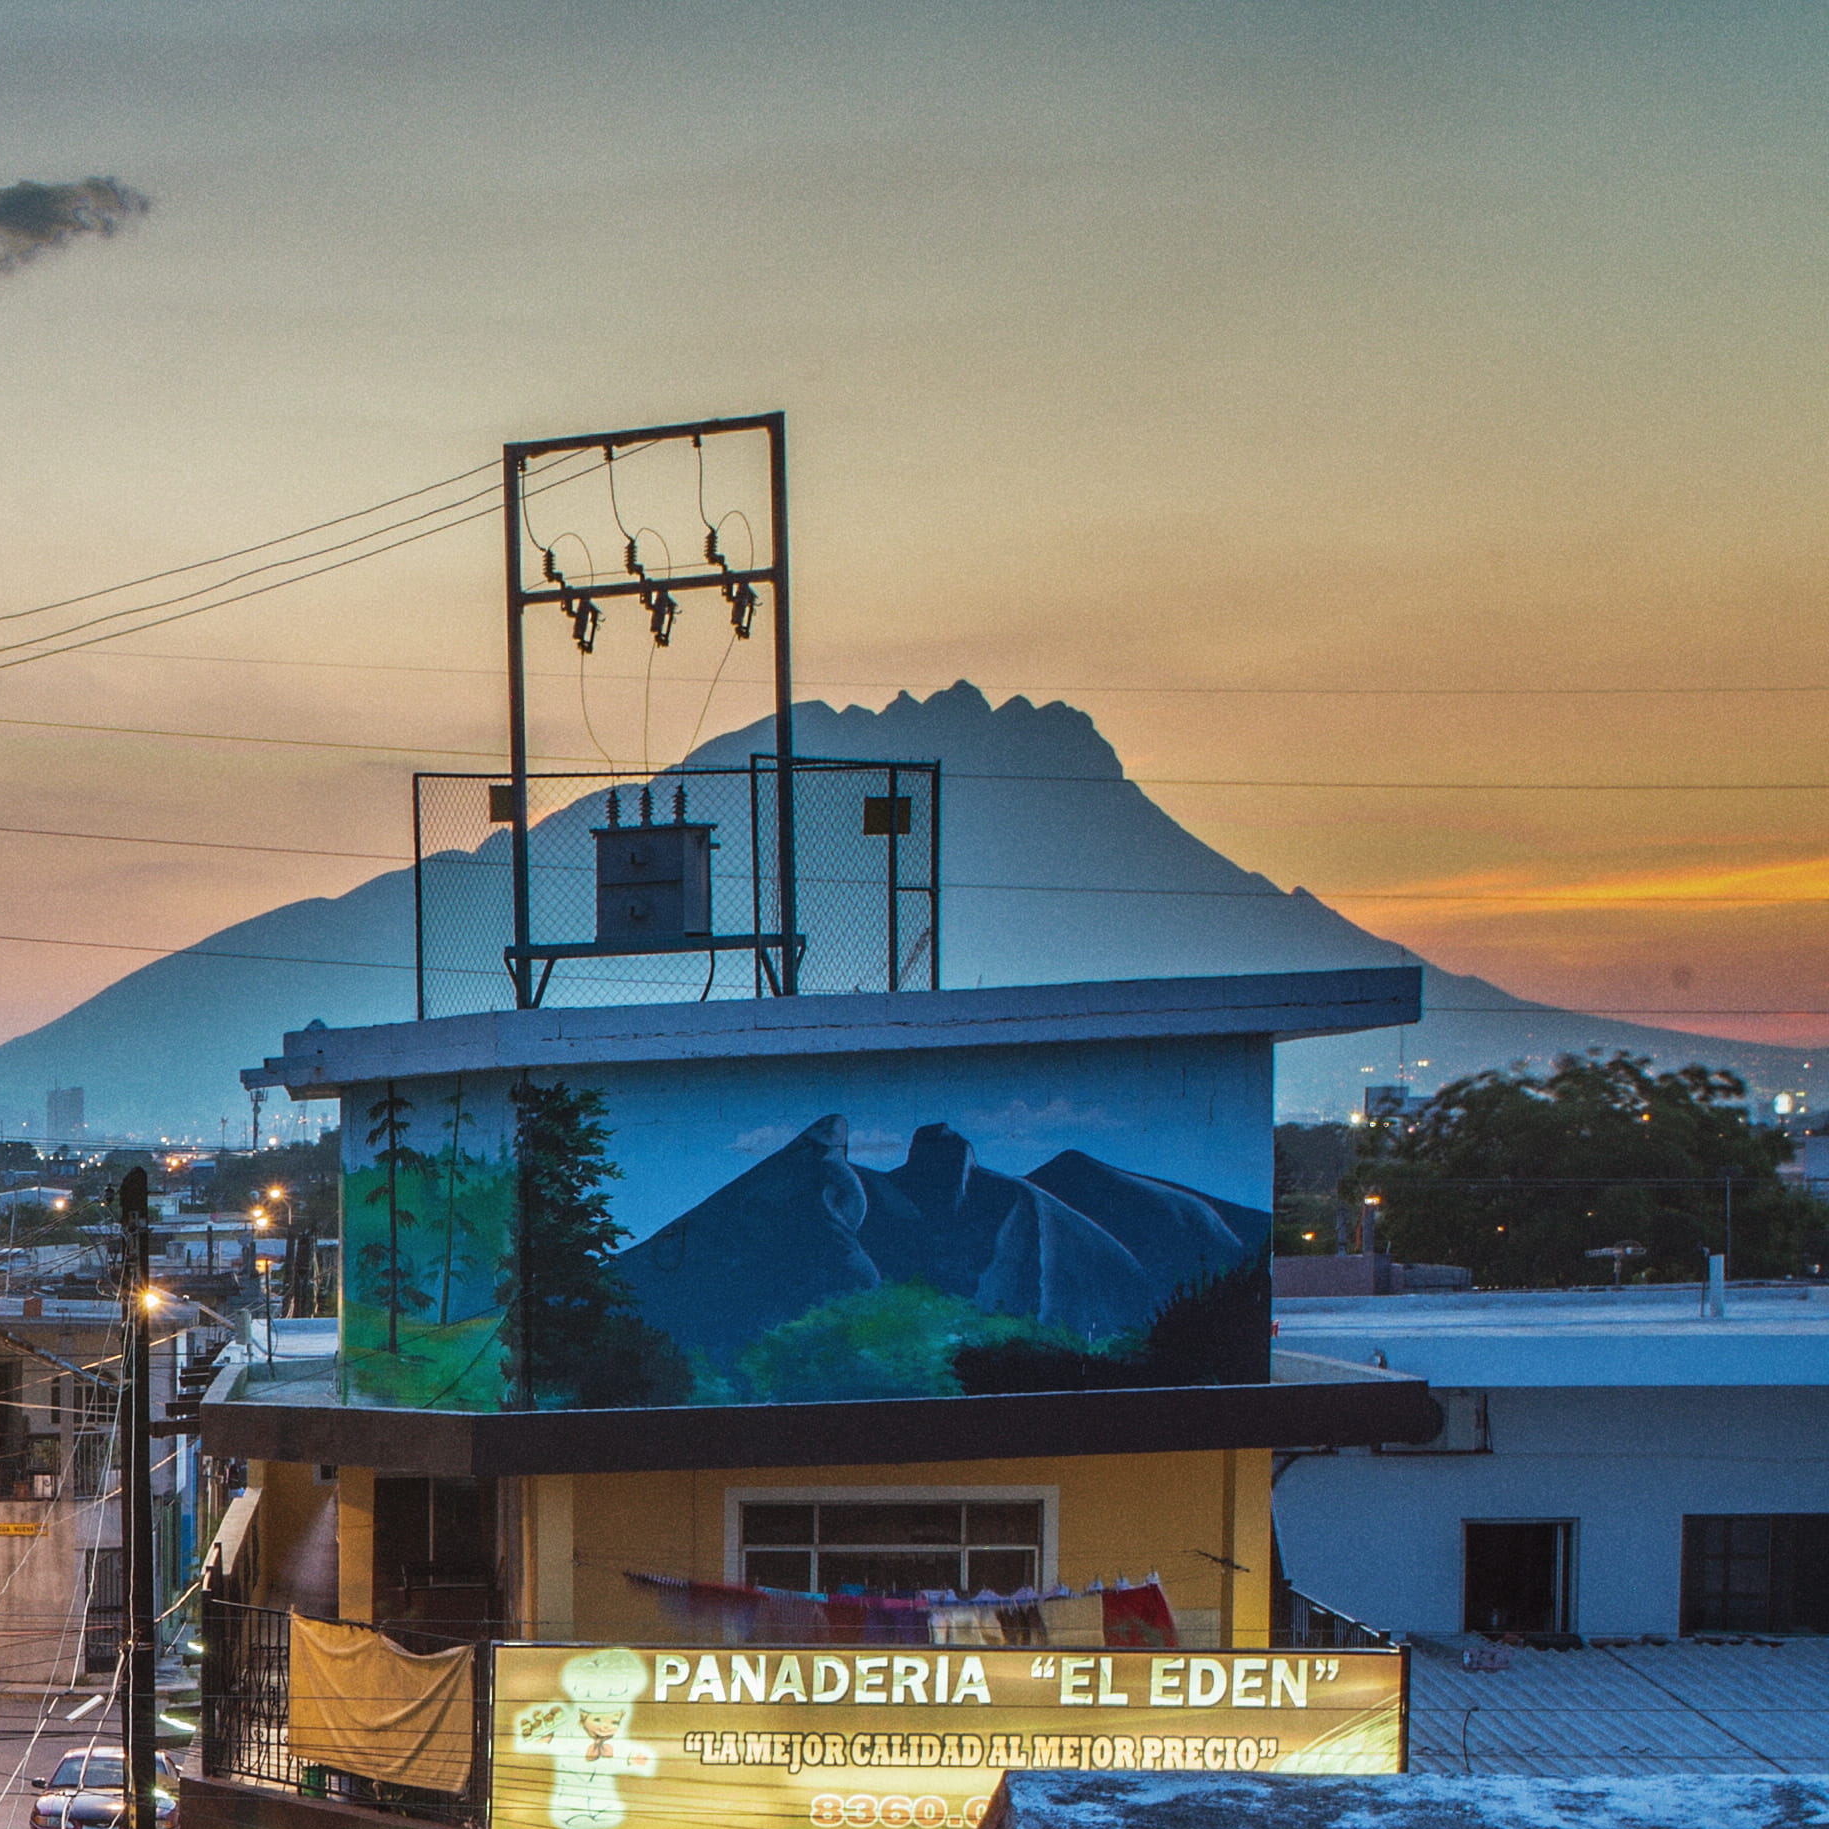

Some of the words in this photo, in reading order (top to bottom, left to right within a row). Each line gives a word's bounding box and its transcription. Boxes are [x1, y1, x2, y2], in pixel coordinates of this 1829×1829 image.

[654, 1654, 992, 1704] PANADERIA
[744, 1732, 847, 1775] MEJOR
[850, 1733, 985, 1768] CALIDAD
[987, 1734, 1029, 1769] AL
[1031, 1734, 1138, 1771] MEJOR
